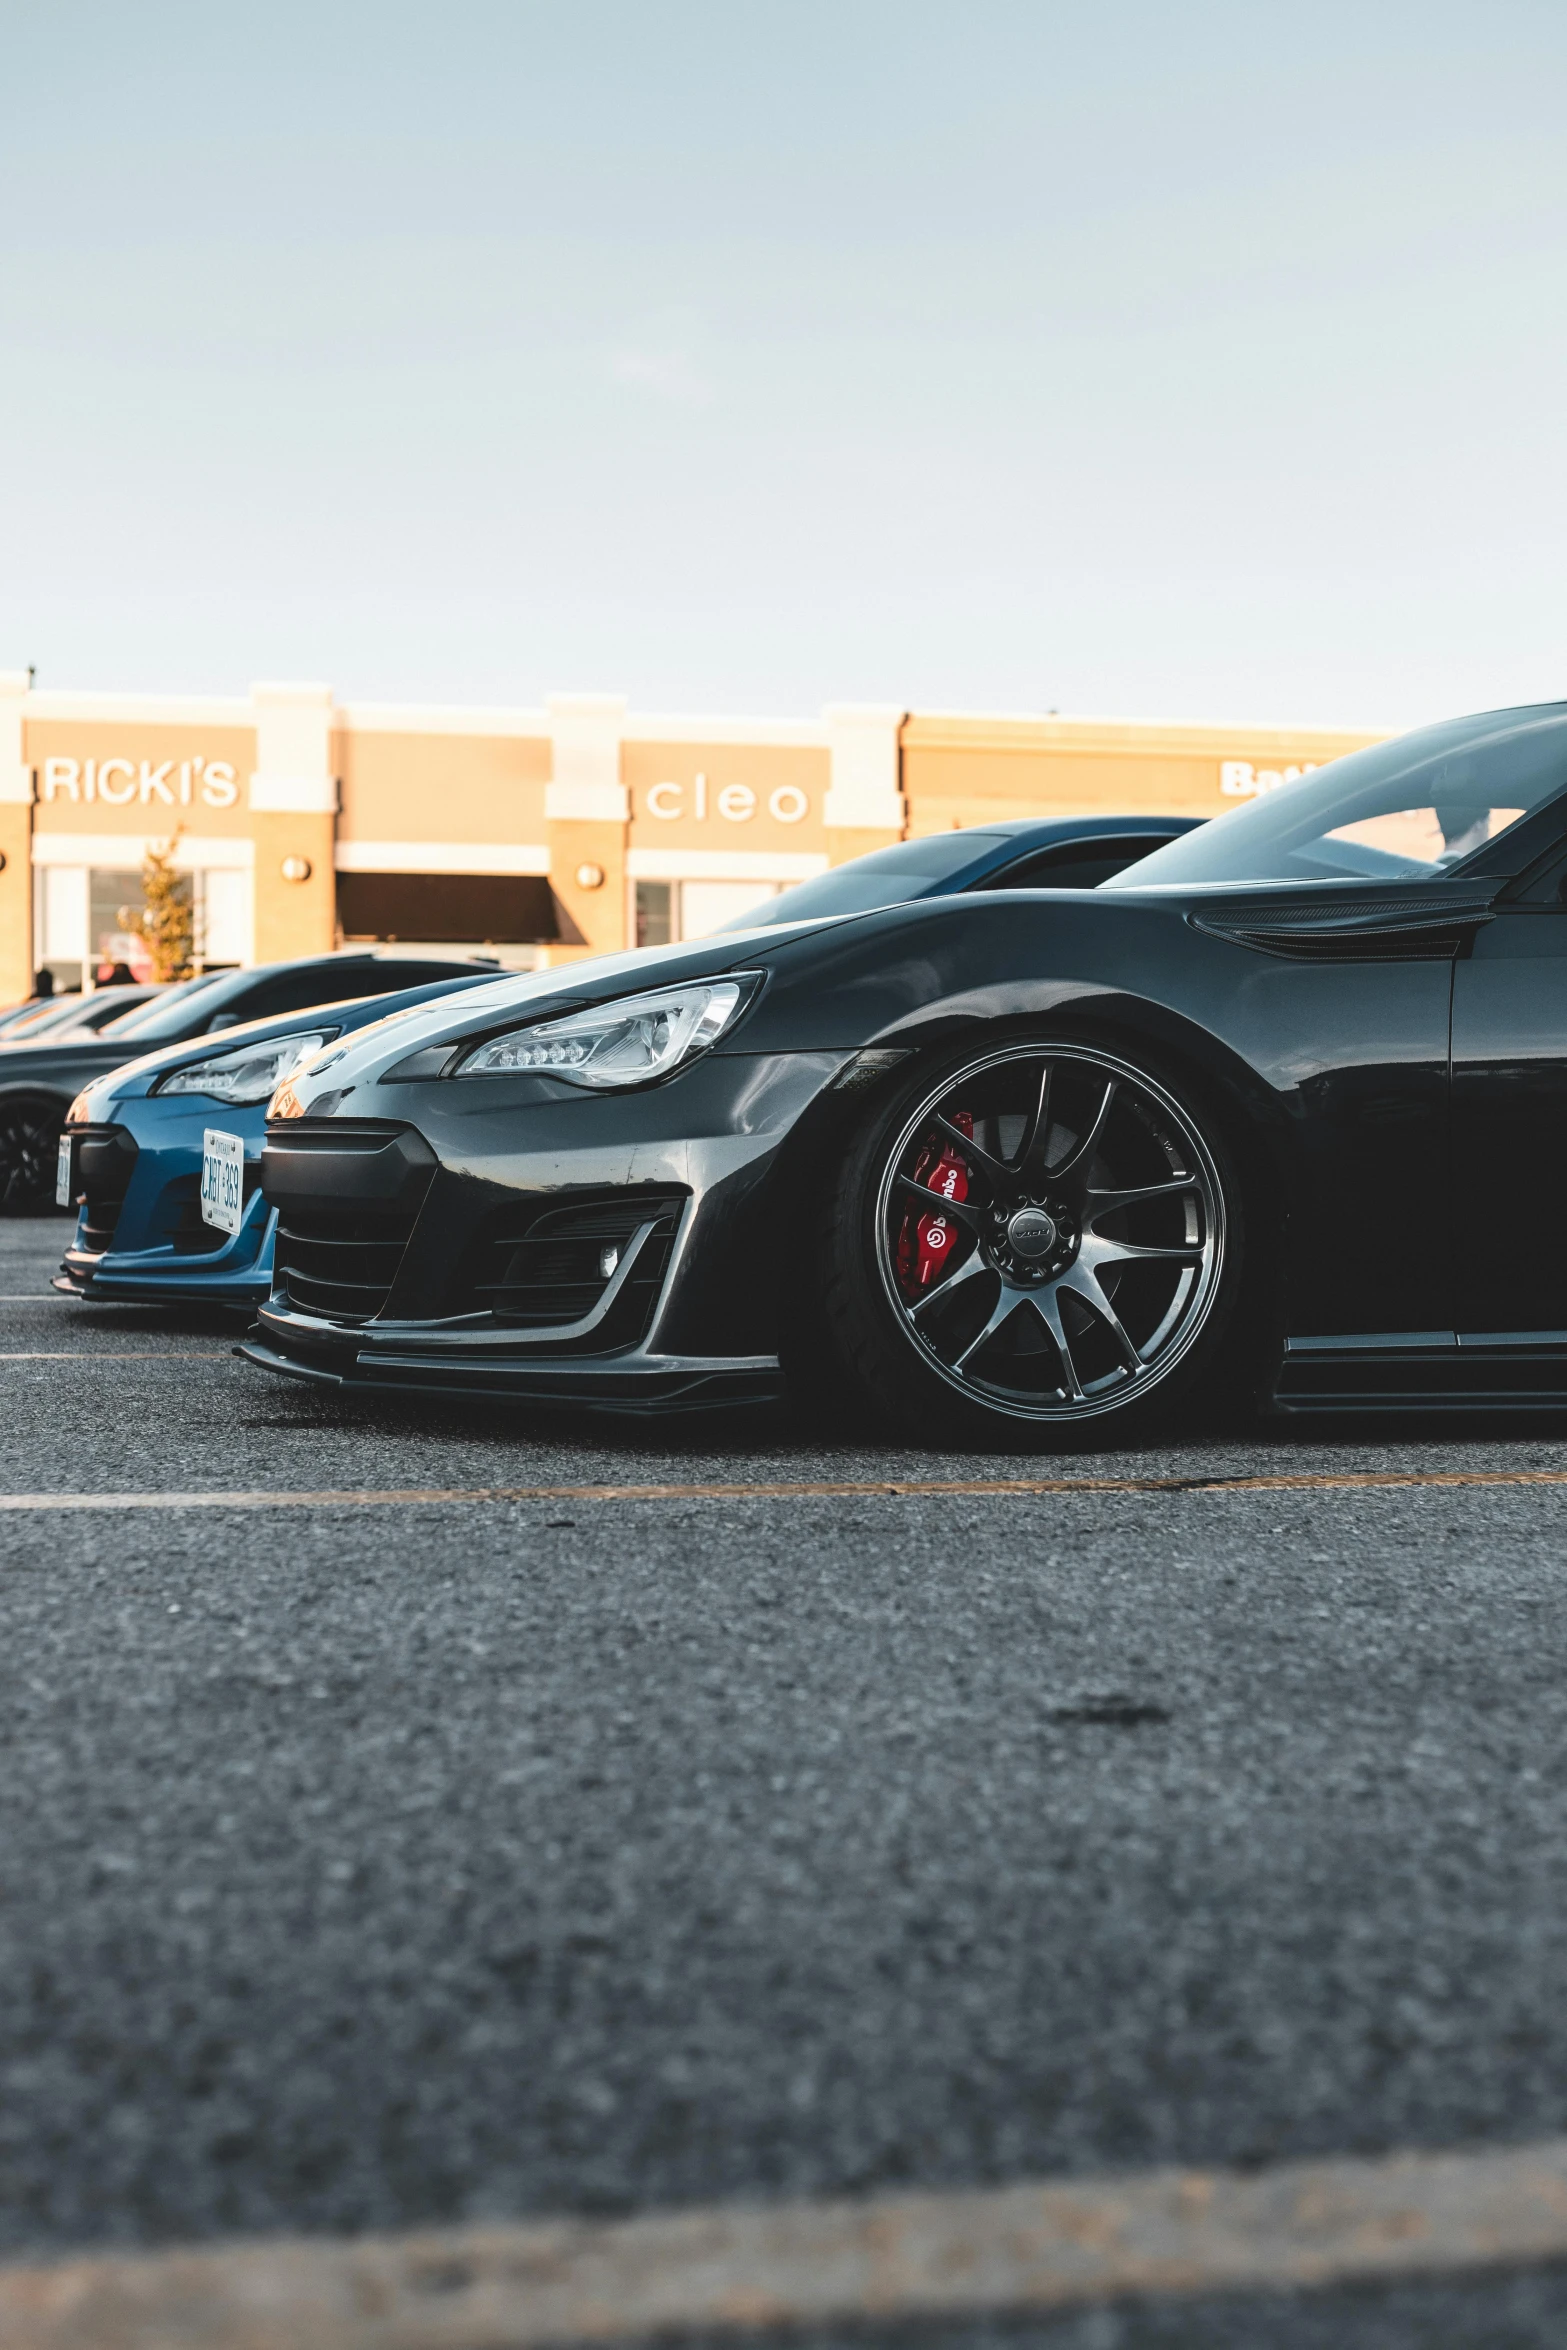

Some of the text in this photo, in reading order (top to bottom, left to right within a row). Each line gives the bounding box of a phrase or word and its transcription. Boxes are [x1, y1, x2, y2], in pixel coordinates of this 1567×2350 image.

[44, 756, 239, 808] RICKI'S
[646, 771, 809, 823] cleo
[224, 1161, 239, 1211] 369
